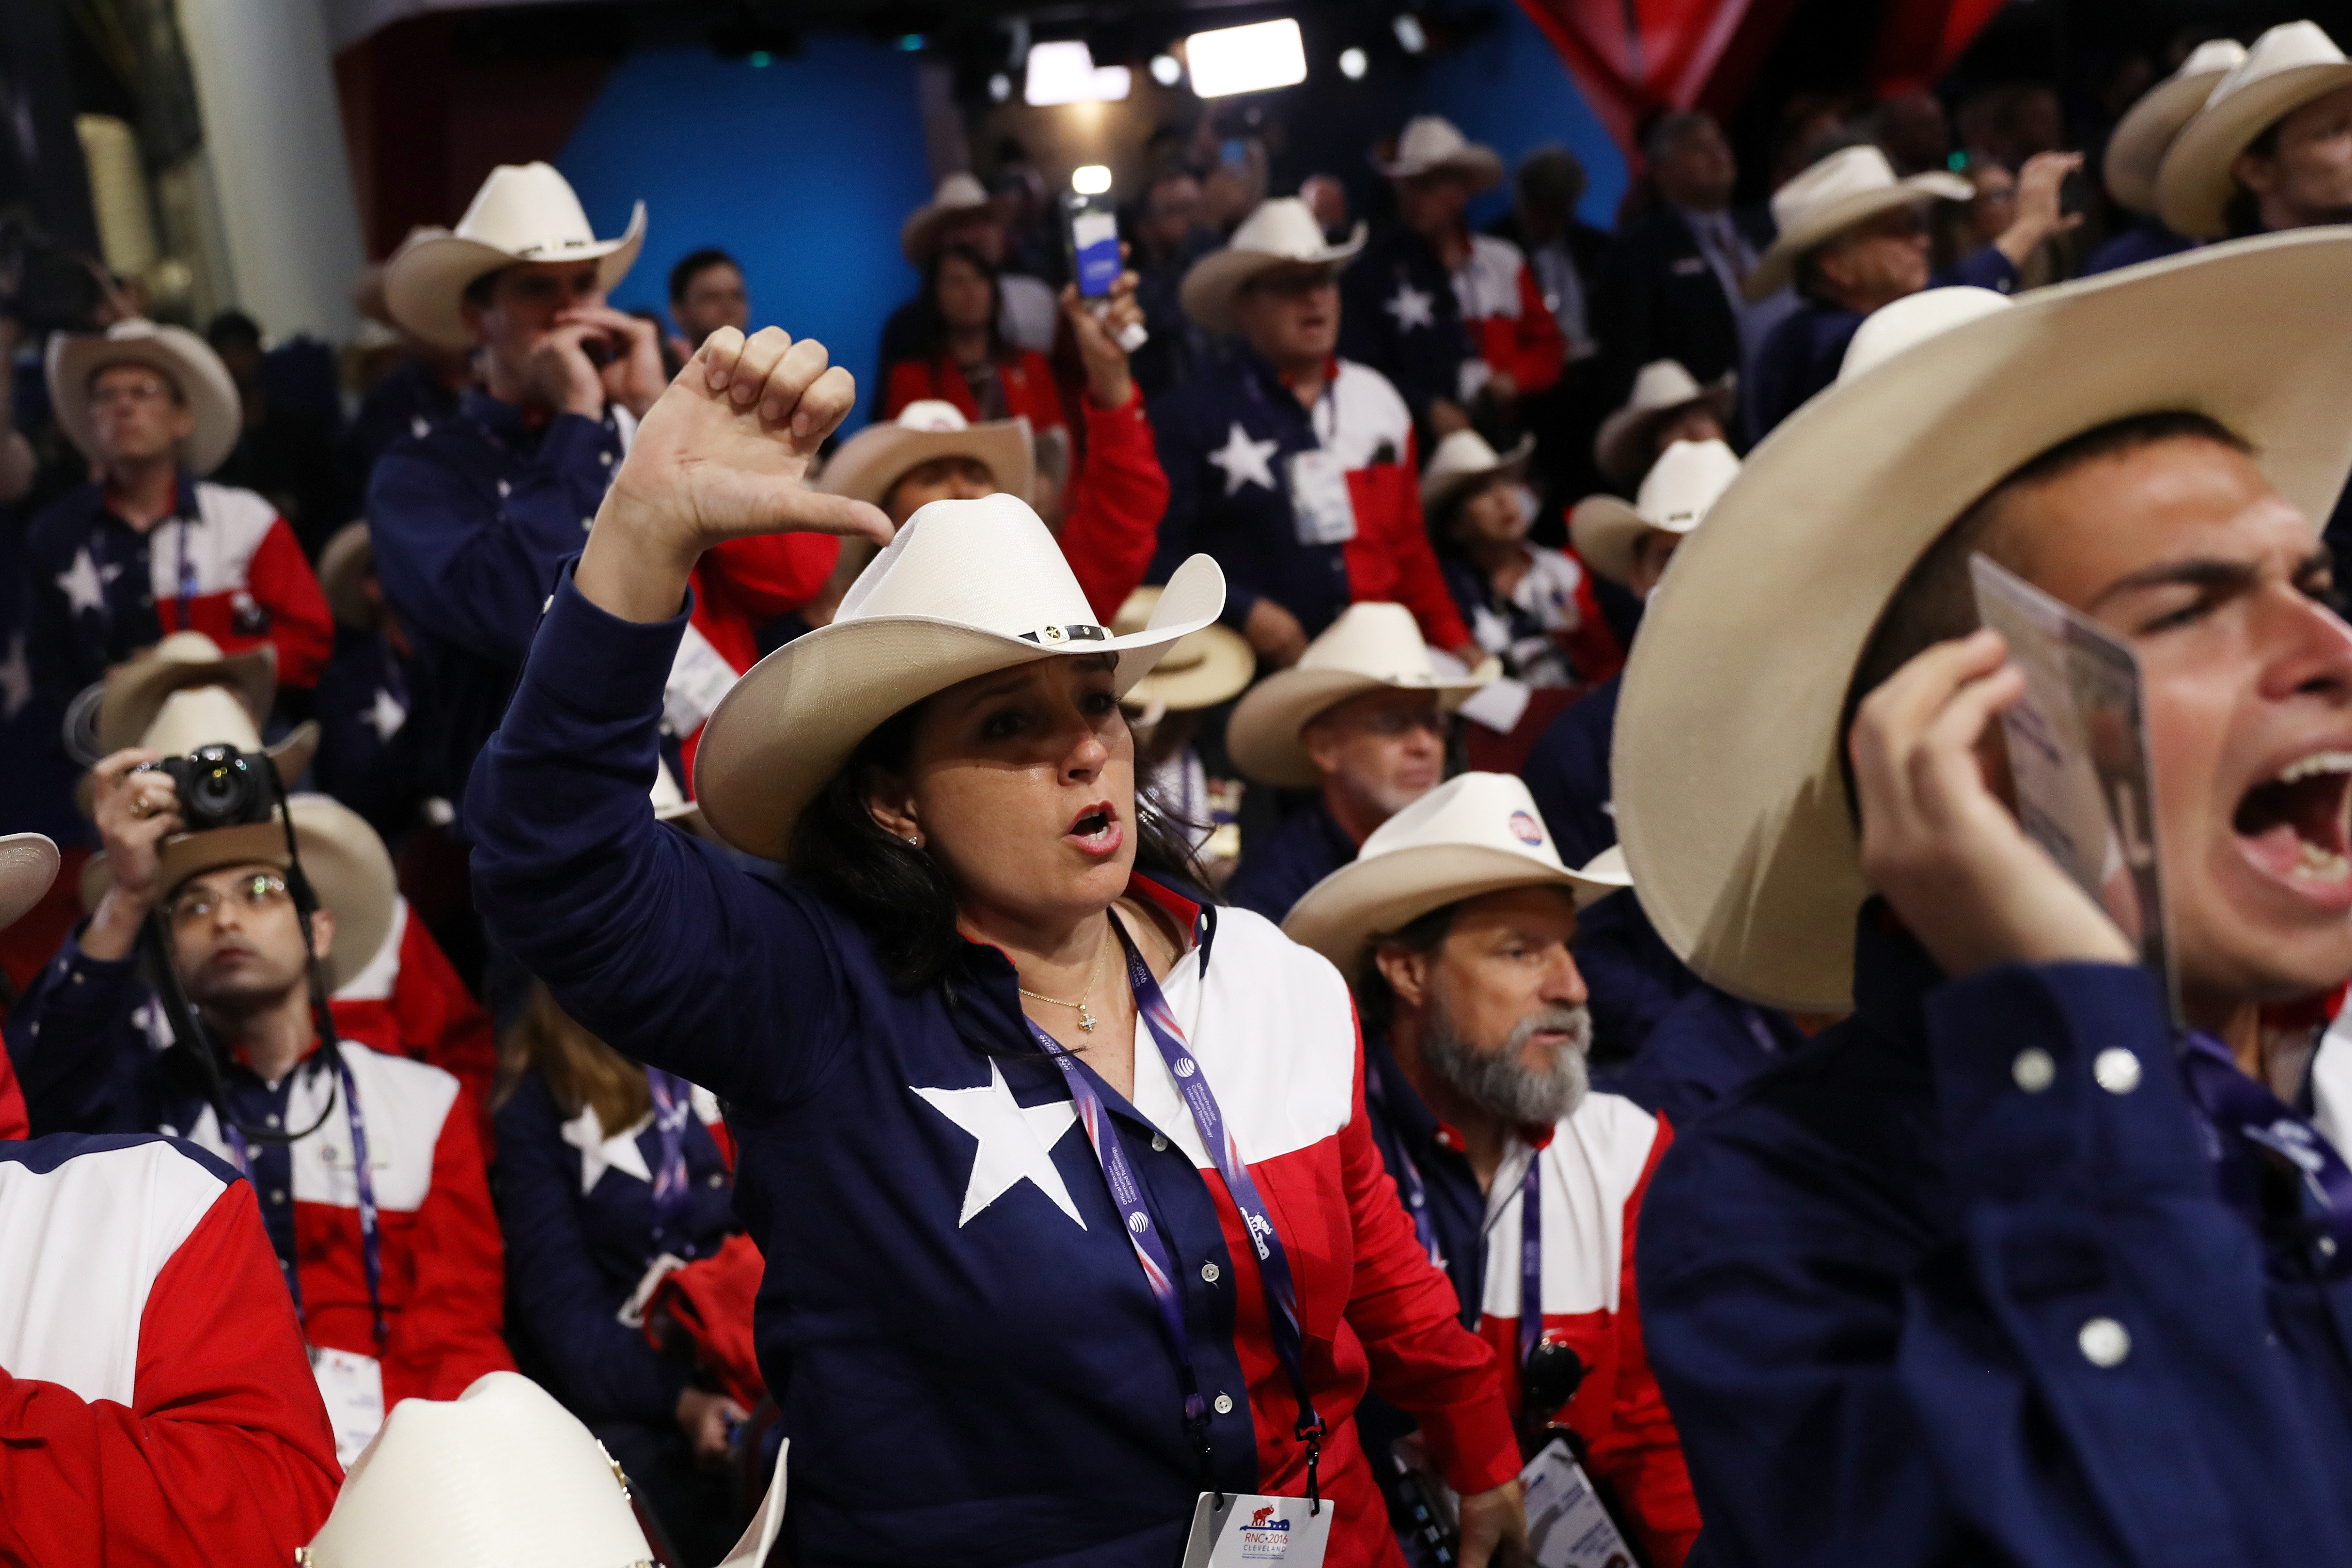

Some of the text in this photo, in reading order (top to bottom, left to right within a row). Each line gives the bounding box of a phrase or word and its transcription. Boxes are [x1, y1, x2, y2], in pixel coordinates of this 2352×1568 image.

[1186, 1087, 1195, 1101] Video
[1198, 1110, 1214, 1138] Technology
[1197, 1083, 1216, 1121] Official Provider
[1111, 1147, 1127, 1176] Technology
[1108, 1166, 1128, 1205] Official Provider
[1129, 1186, 1137, 1201] Video
[1243, 1544, 1286, 1552] CLEVELAND
